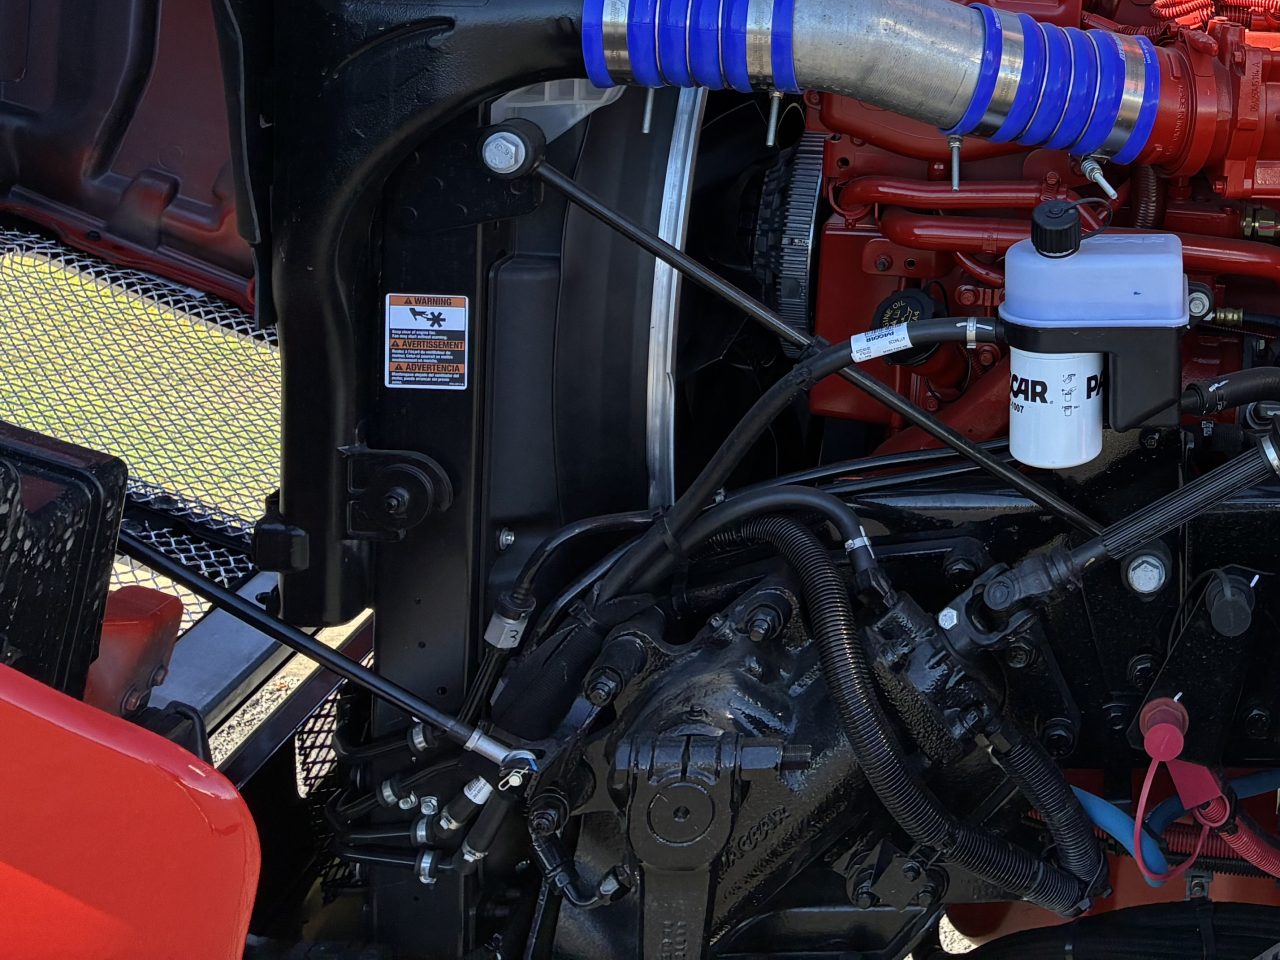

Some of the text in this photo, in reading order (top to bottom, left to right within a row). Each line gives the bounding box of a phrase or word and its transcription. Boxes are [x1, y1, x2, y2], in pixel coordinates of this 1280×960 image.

[414, 297, 452, 305] WARNING
[402, 341, 463, 349] AVERTISSEMENT
[406, 363, 460, 372] ADVERTENCIA
[1009, 373, 1048, 404] CAR
